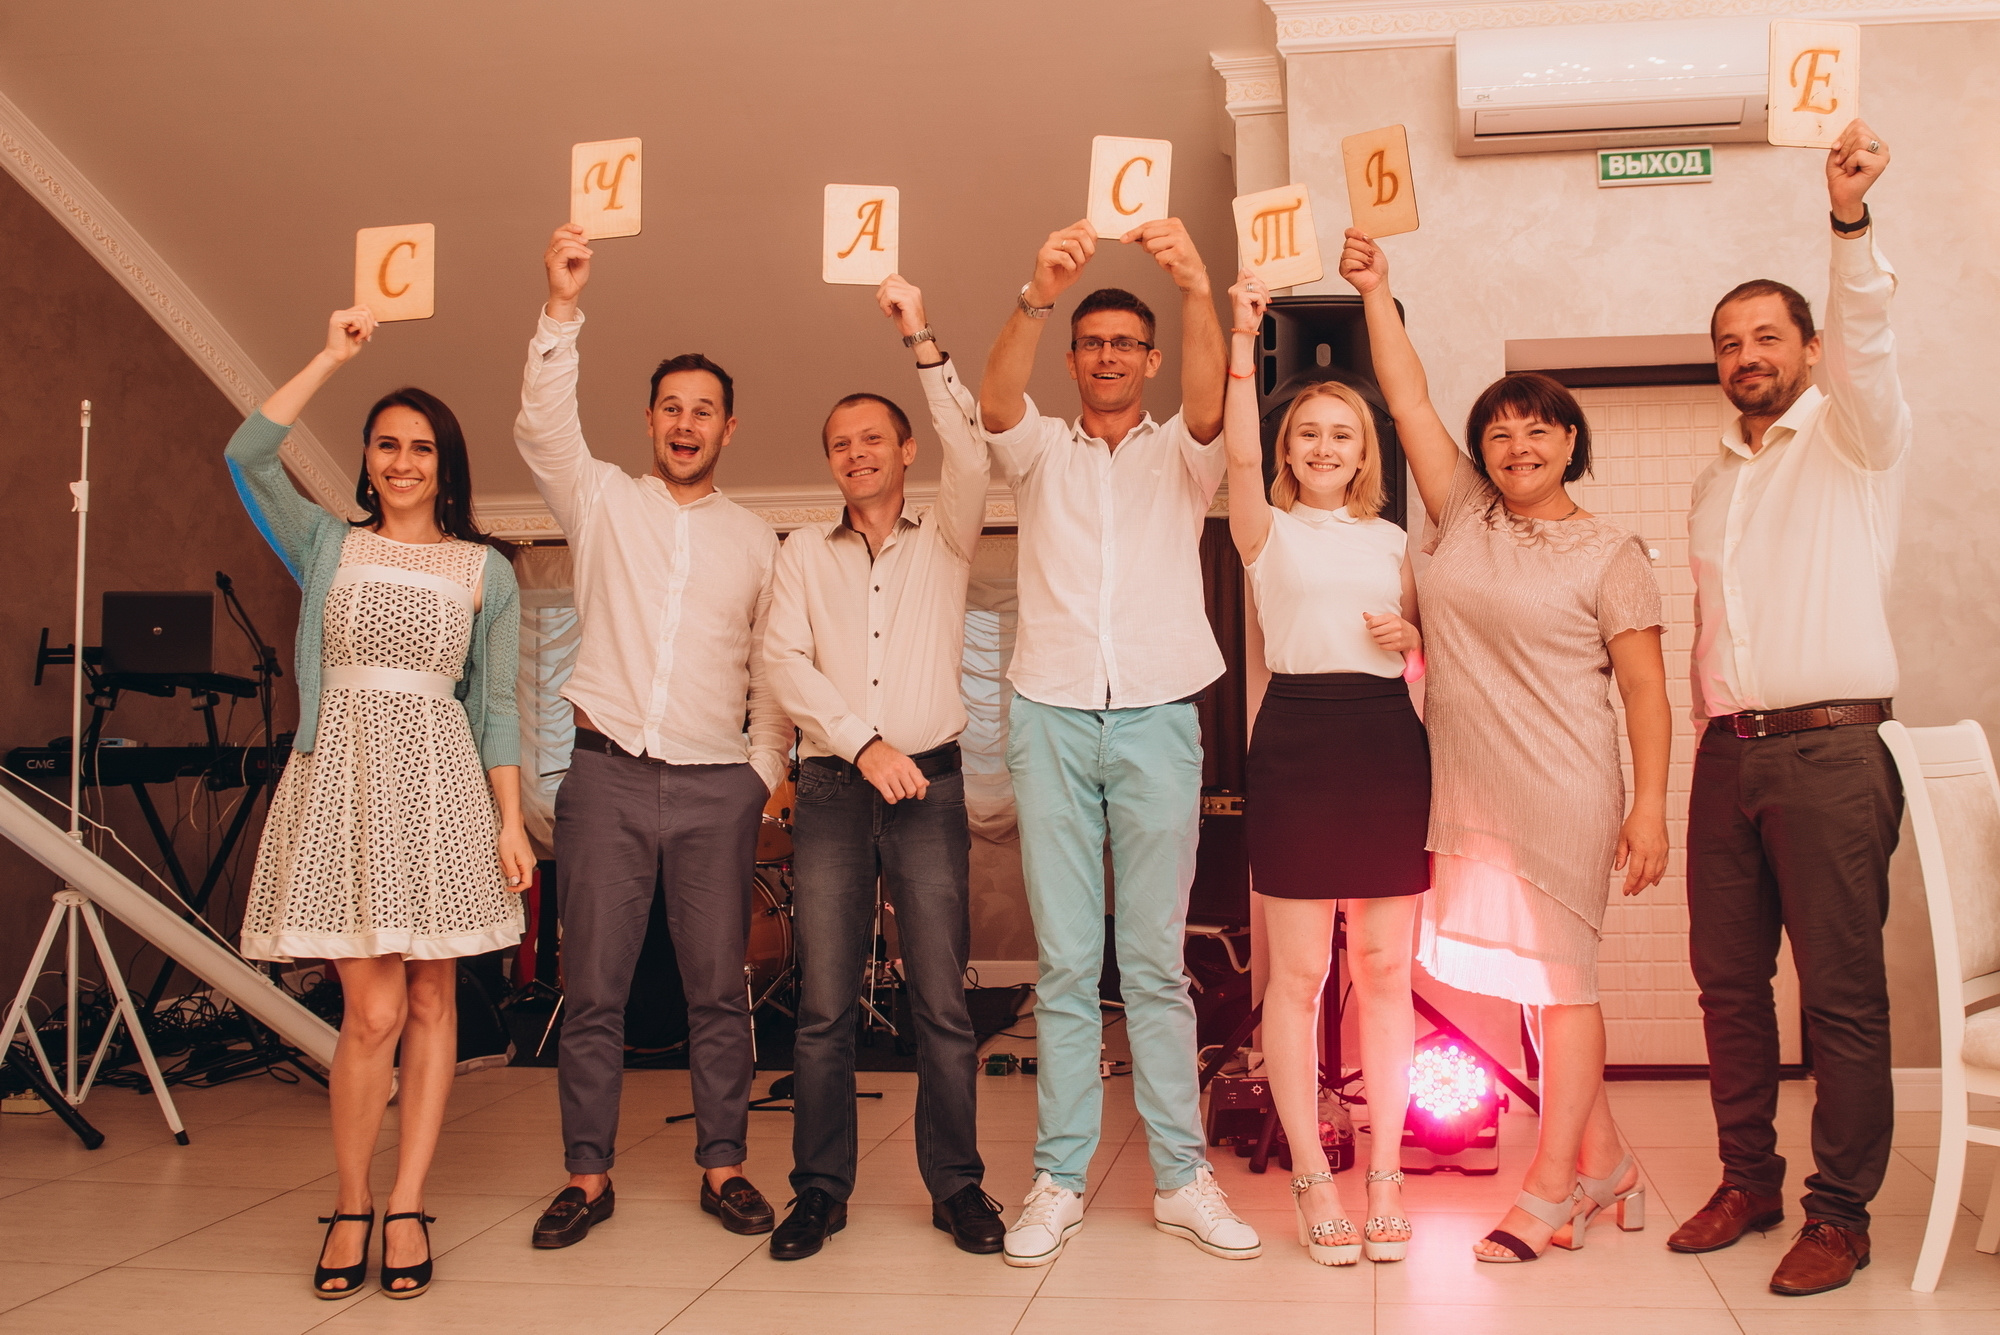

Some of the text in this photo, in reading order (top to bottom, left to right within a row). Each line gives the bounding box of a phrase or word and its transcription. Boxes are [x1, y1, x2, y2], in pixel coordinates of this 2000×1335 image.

[1789, 48, 1840, 115] Е
[583, 153, 636, 211] Ч
[1111, 156, 1153, 216] С
[1364, 149, 1399, 208] Ь
[1608, 151, 1704, 177] ВЫХОД
[836, 199, 886, 260] А
[1251, 197, 1303, 266] Т
[377, 240, 417, 298] С
[26, 759, 56, 769] CME
